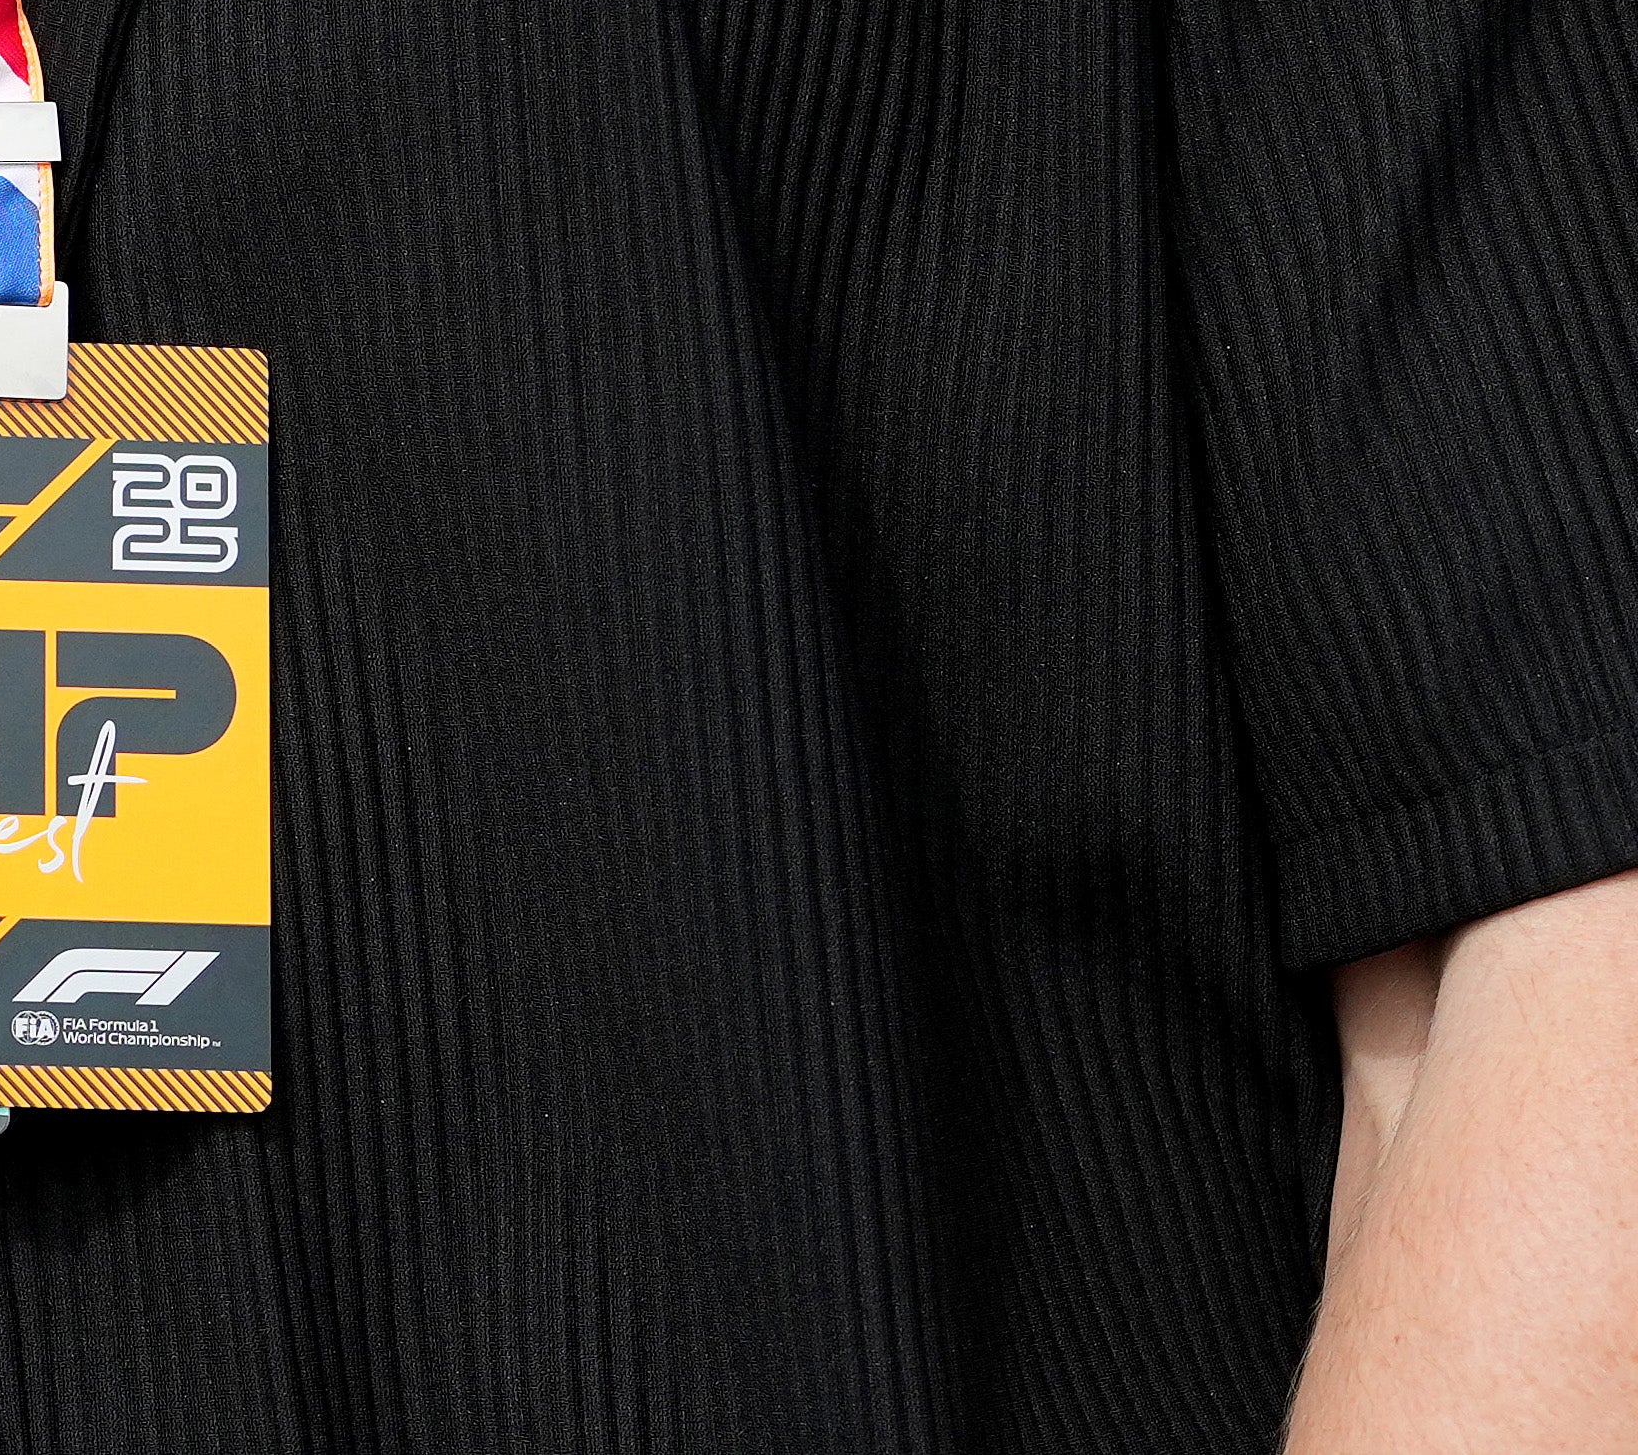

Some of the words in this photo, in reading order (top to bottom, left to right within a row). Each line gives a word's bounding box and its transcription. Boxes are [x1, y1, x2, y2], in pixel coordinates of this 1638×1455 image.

[10, 947, 222, 1007] F1
[62, 1016, 88, 1032] FIA
[89, 1018, 150, 1033] Formula
[150, 1019, 160, 1033] 1
[62, 1031, 107, 1046] World
[108, 1033, 211, 1050] Championship
